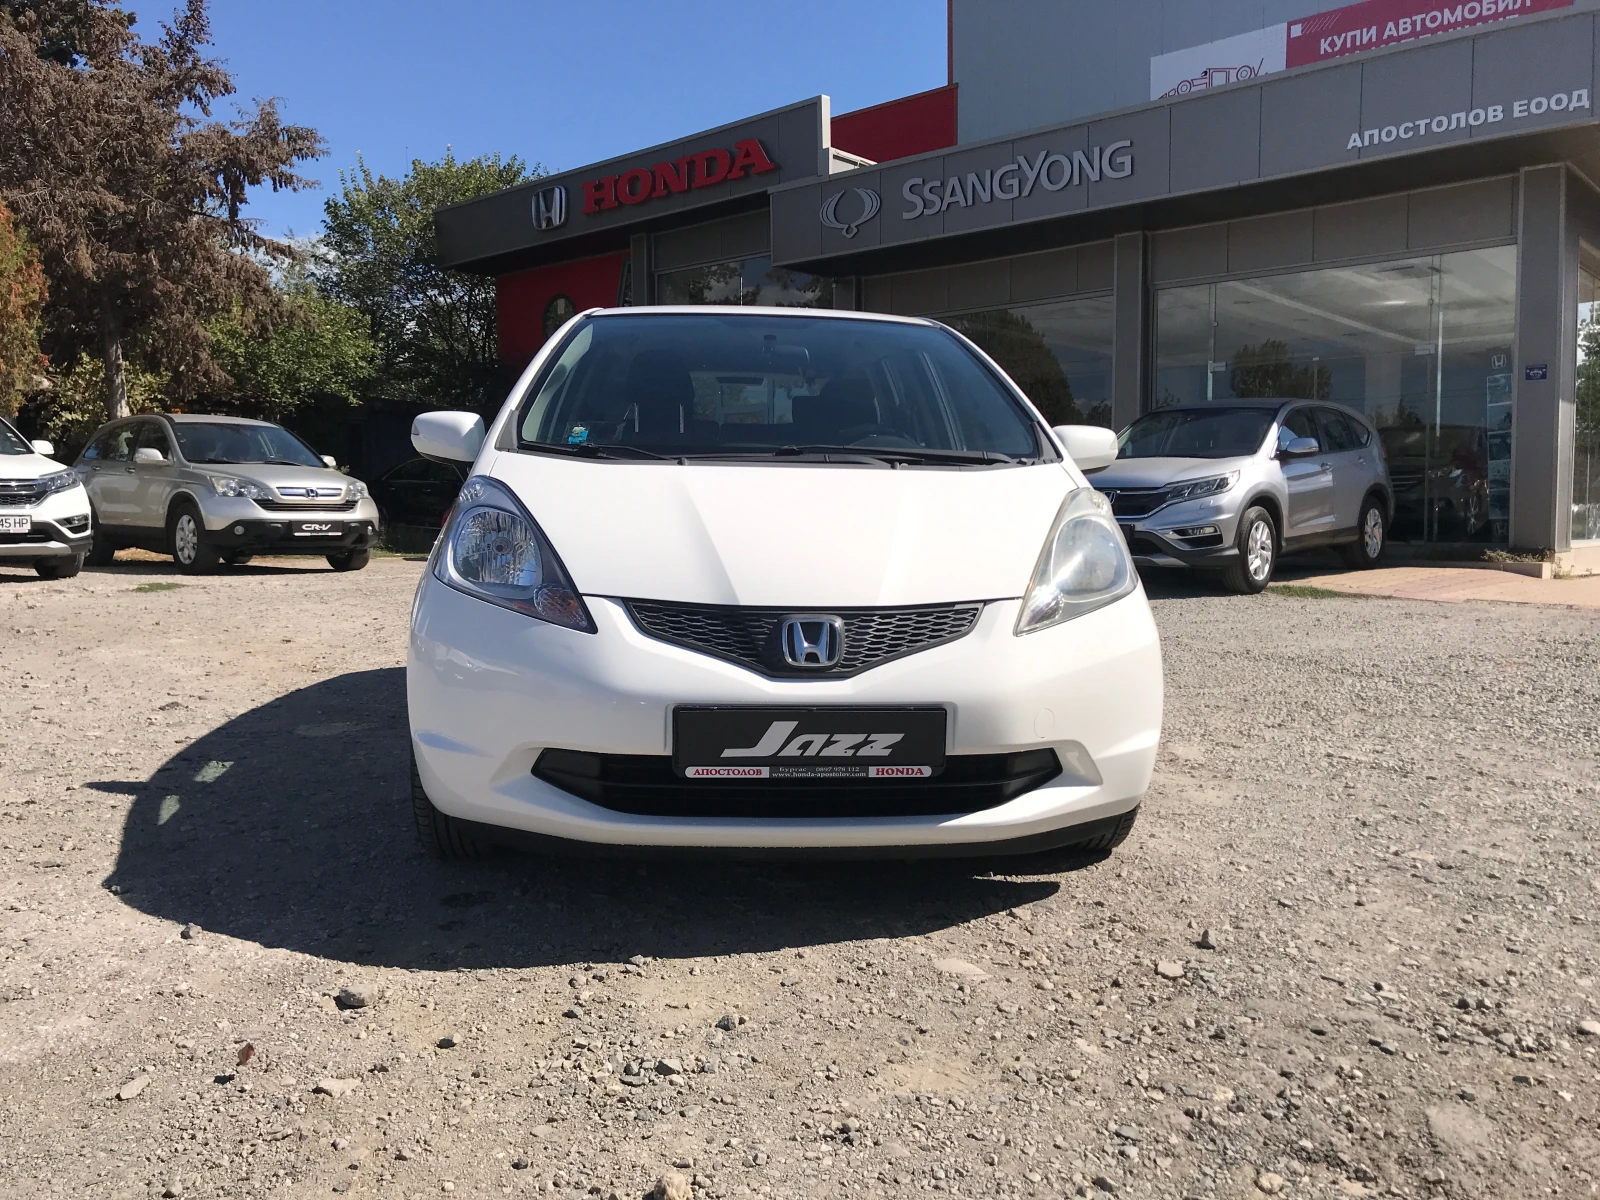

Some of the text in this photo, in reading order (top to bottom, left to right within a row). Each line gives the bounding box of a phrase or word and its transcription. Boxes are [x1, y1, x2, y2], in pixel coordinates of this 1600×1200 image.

[1320, 26, 1377, 55] КУПИ
[1346, 88, 1590, 150] АПОСТОЛОВ ЕООД
[582, 138, 776, 214] HONDA
[14, 518, 28, 528] HP
[720, 721, 905, 757] Jazz
[693, 768, 762, 776] АПОСТОЛОВ
[875, 767, 924, 776] HONDA
